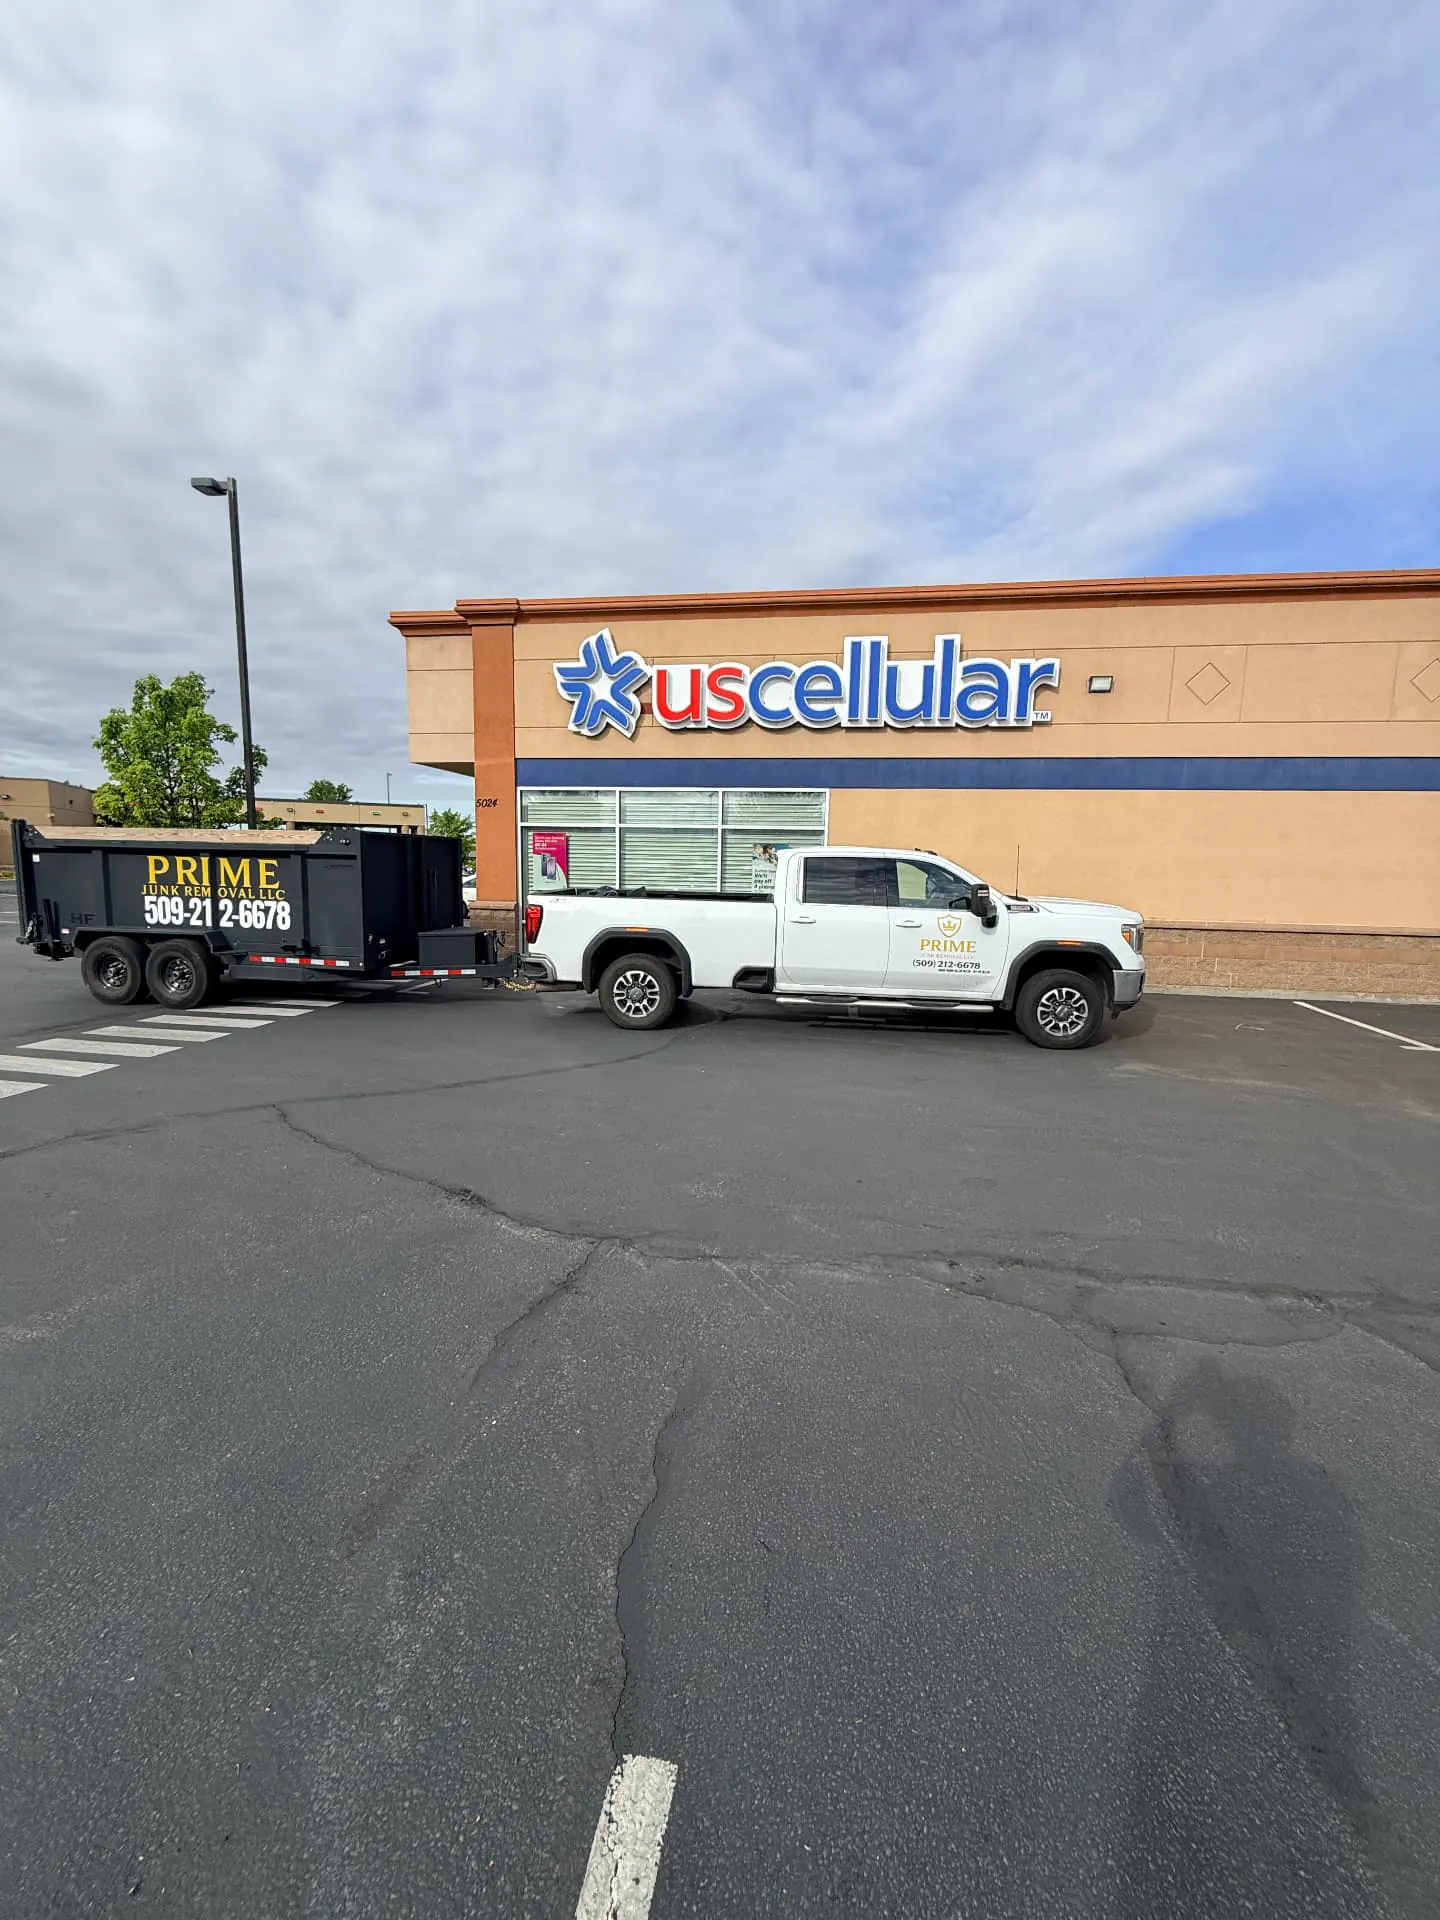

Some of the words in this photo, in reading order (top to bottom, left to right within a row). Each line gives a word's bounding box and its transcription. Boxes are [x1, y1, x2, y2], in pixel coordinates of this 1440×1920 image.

[475, 798, 498, 808] 5024
[147, 855, 281, 889] PRIME
[141, 884, 180, 896] JUNK
[259, 889, 287, 900] LLC
[920, 939, 977, 953] PRIME
[912, 959, 936, 968] (509)
[938, 960, 981, 969] 212-6678
